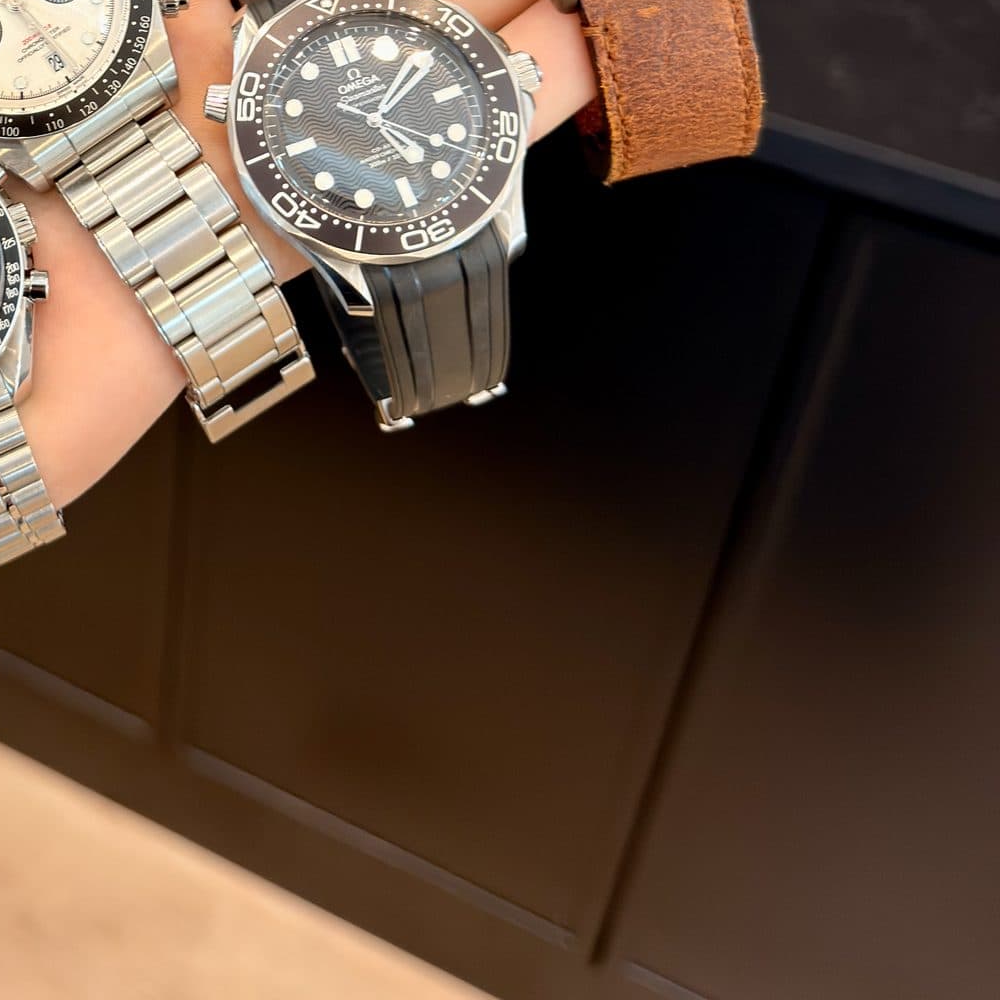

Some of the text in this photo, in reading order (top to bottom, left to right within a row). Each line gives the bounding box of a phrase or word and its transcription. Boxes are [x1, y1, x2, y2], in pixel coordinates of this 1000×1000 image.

[138, 15, 151, 34] 160
[437, 6, 475, 38] 10
[131, 36, 146, 54] 150
[121, 57, 137, 76] 140
[103, 79, 122, 97] 130
[337, 74, 380, 94] OMEGA
[236, 72, 261, 122] 50
[80, 101, 99, 117] 120
[1, 126, 20, 137] 100
[45, 118, 65, 132] 110
[496, 111, 518, 164] 20
[271, 191, 321, 230] 40
[400, 218, 455, 251] 30
